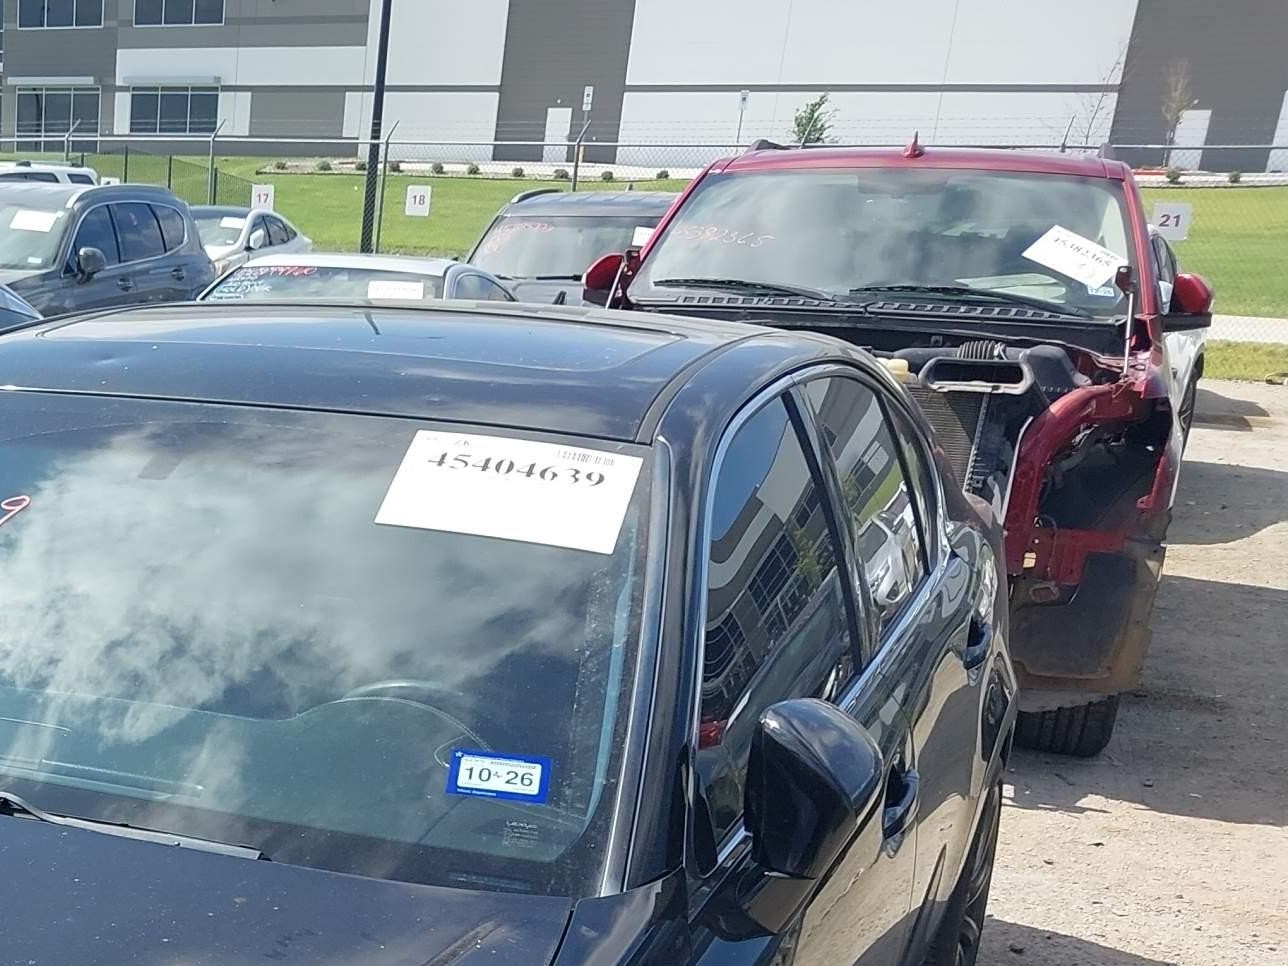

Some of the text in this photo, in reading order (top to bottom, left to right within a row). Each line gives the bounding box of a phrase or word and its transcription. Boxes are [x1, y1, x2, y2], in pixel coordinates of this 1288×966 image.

[256, 193, 270, 204] 17
[412, 195, 426, 206] 18
[1158, 213, 1182, 228] 21
[427, 451, 606, 488] 45404639
[464, 766, 535, 788] 10-26
